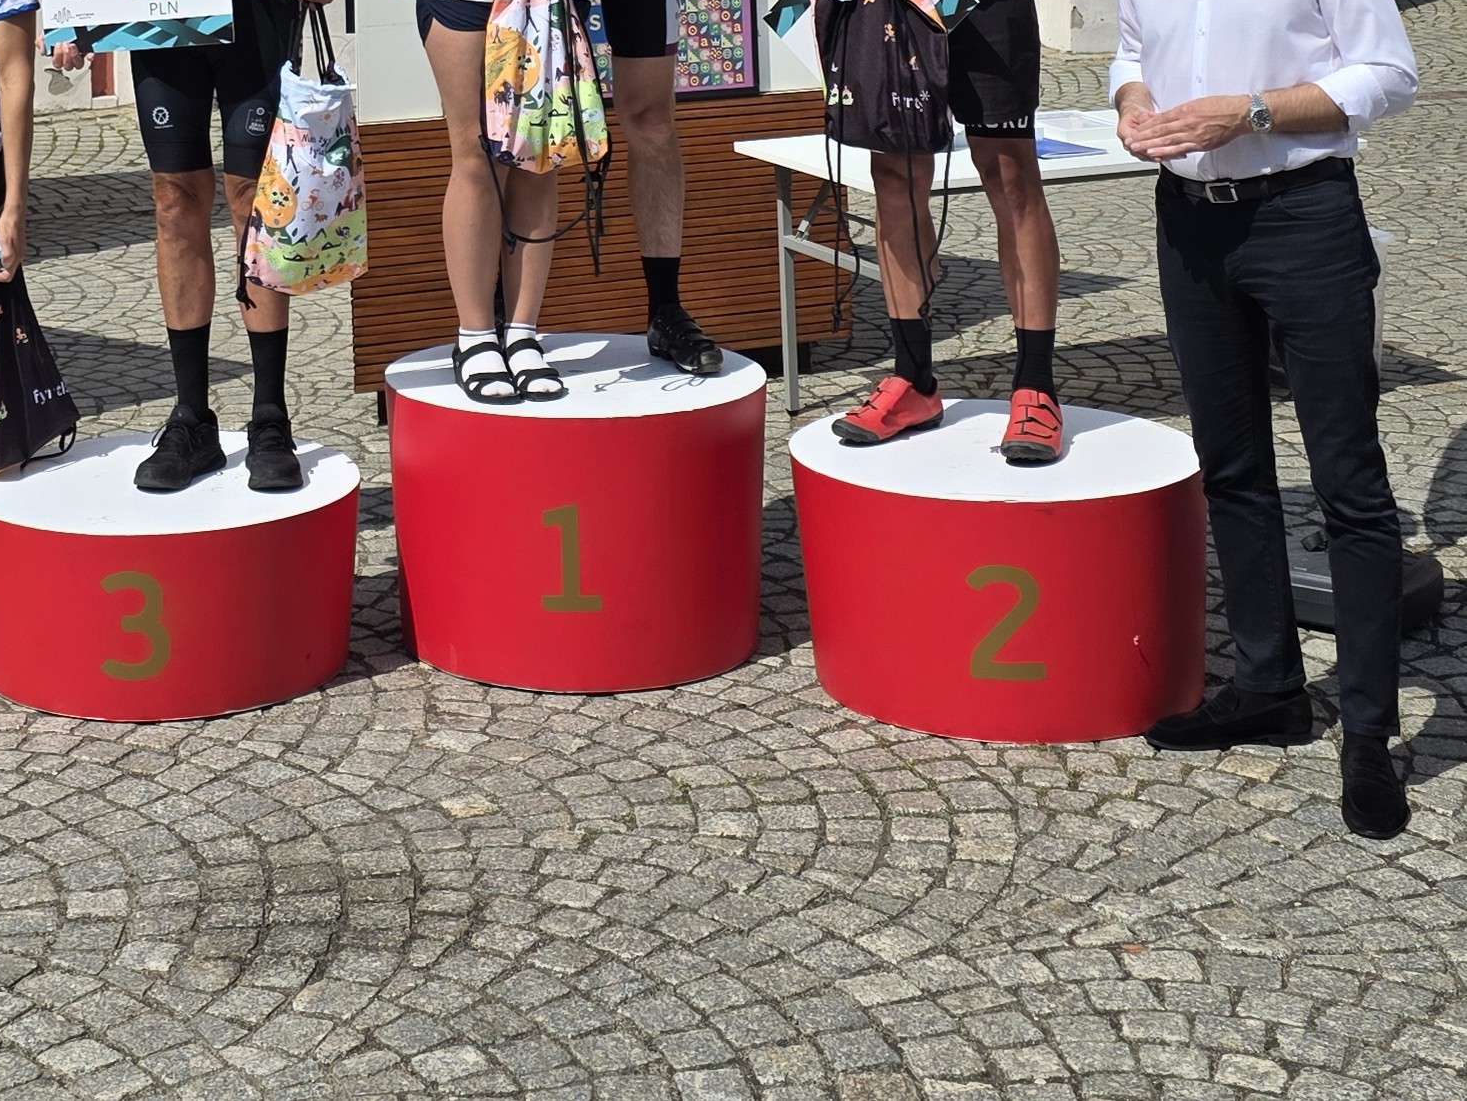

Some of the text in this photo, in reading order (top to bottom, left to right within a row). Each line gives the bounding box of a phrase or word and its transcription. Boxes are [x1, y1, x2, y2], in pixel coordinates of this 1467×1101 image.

[149, 1, 179, 16] PLN
[540, 504, 603, 612] 1
[100, 570, 171, 680] 3
[965, 564, 1047, 680] 2
